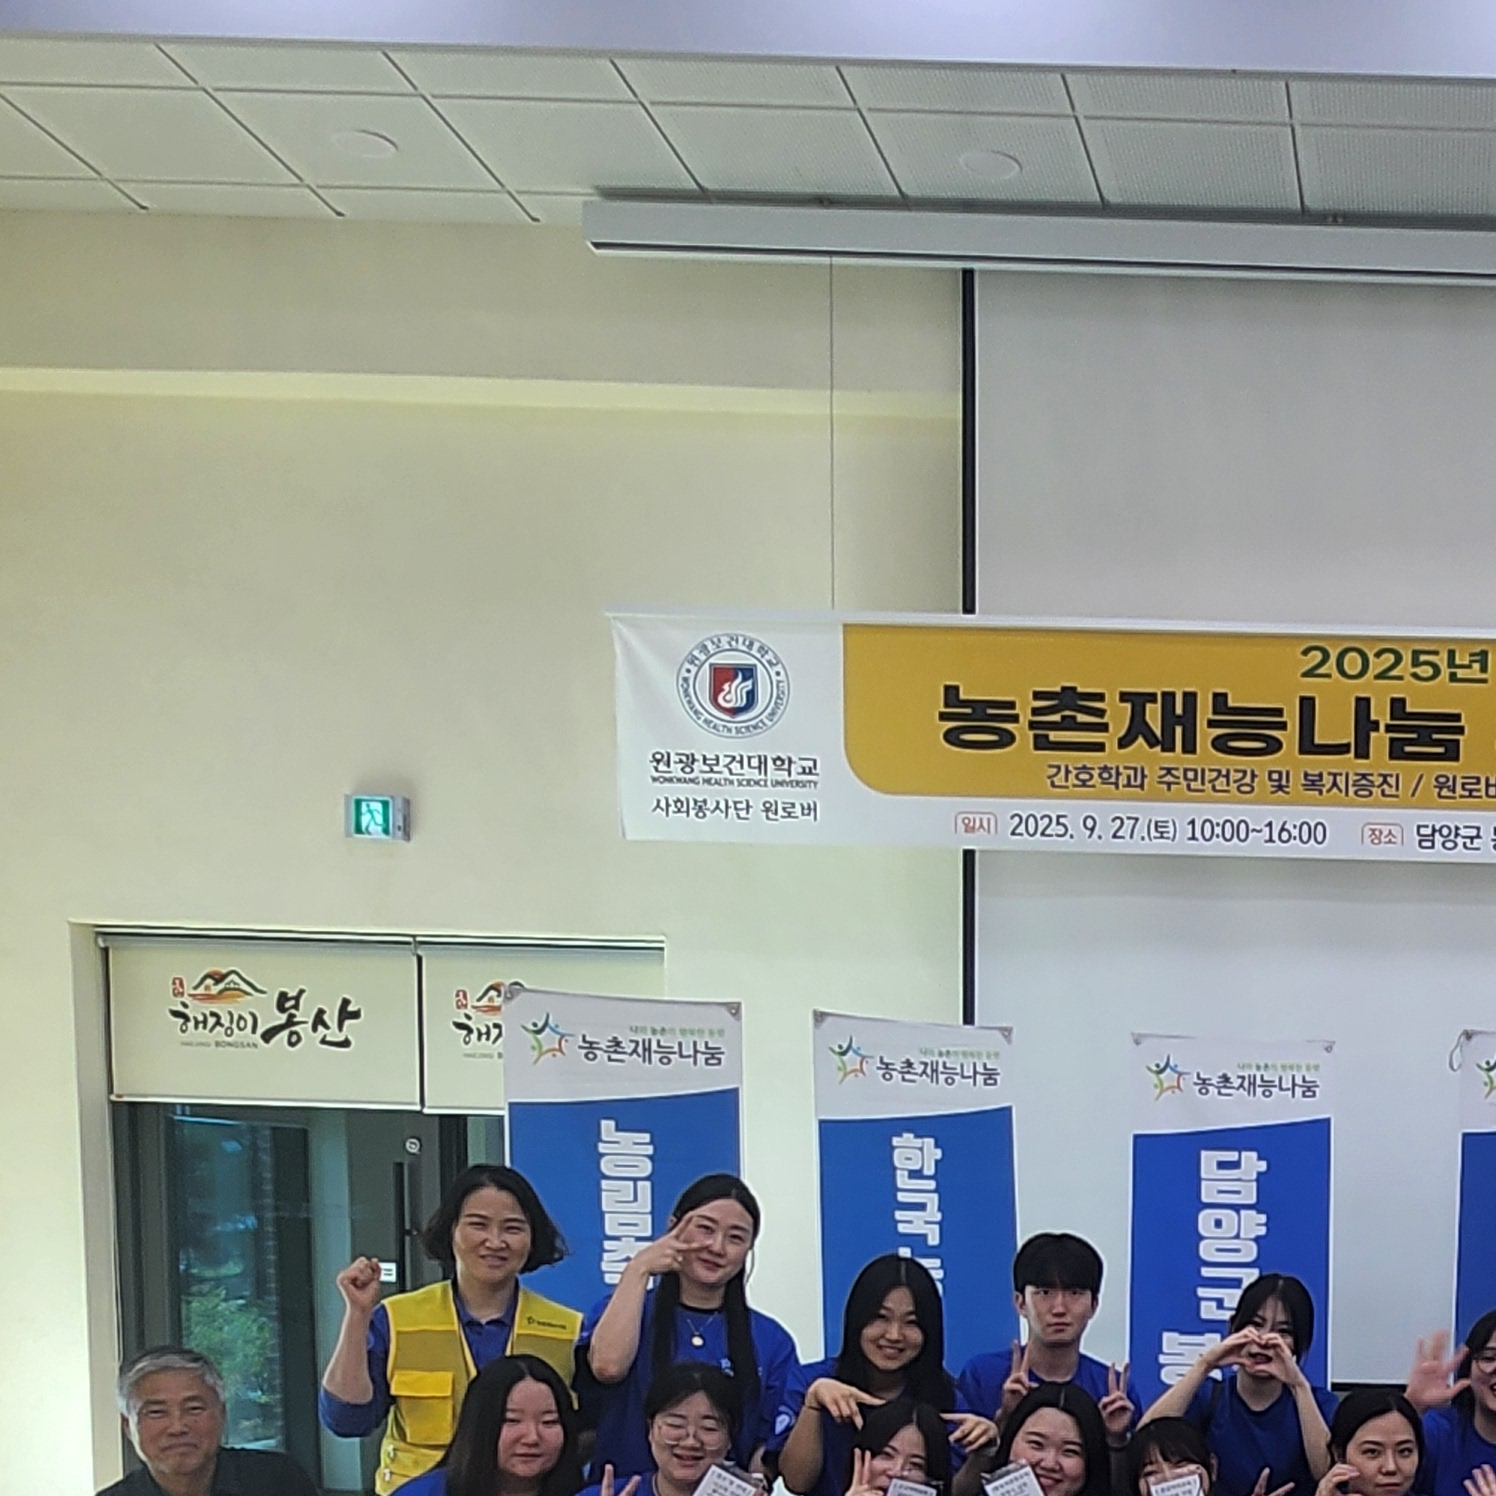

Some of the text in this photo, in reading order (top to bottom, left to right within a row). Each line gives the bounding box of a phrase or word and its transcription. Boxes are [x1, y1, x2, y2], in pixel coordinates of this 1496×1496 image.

[1300, 645, 1489, 684] 2025년
[702, 717, 733, 735] HEALTH
[734, 719, 768, 736] SCIENCE
[938, 684, 1466, 764] 농촌재능나눔
[650, 751, 819, 778] 원광보건대학교
[650, 775, 819, 790] WONKWANG HEALTH SCIENCE UNIVERSITY
[1046, 764, 1147, 792] 간호학과
[1156, 766, 1258, 796] 주민건강
[1267, 769, 1291, 796] 및
[1301, 771, 1401, 798] 복지증진
[1410, 773, 1424, 799] /
[652, 797, 818, 822] 사회봉사단 원로버
[962, 815, 991, 834] 일시
[1009, 813, 1327, 846] 2025. 9. 27.(토) 10:00~16:00
[1368, 827, 1398, 846] 장소
[1416, 823, 1482, 853] 담양군
[260, 988, 361, 1049] 봉산
[578, 1034, 725, 1067] 농촌재능나눔
[876, 1055, 1000, 1087] 농촌재능나눔
[1193, 1071, 1320, 1099] 농촌재능나눔
[1196, 1150, 1268, 1321] 담양군
